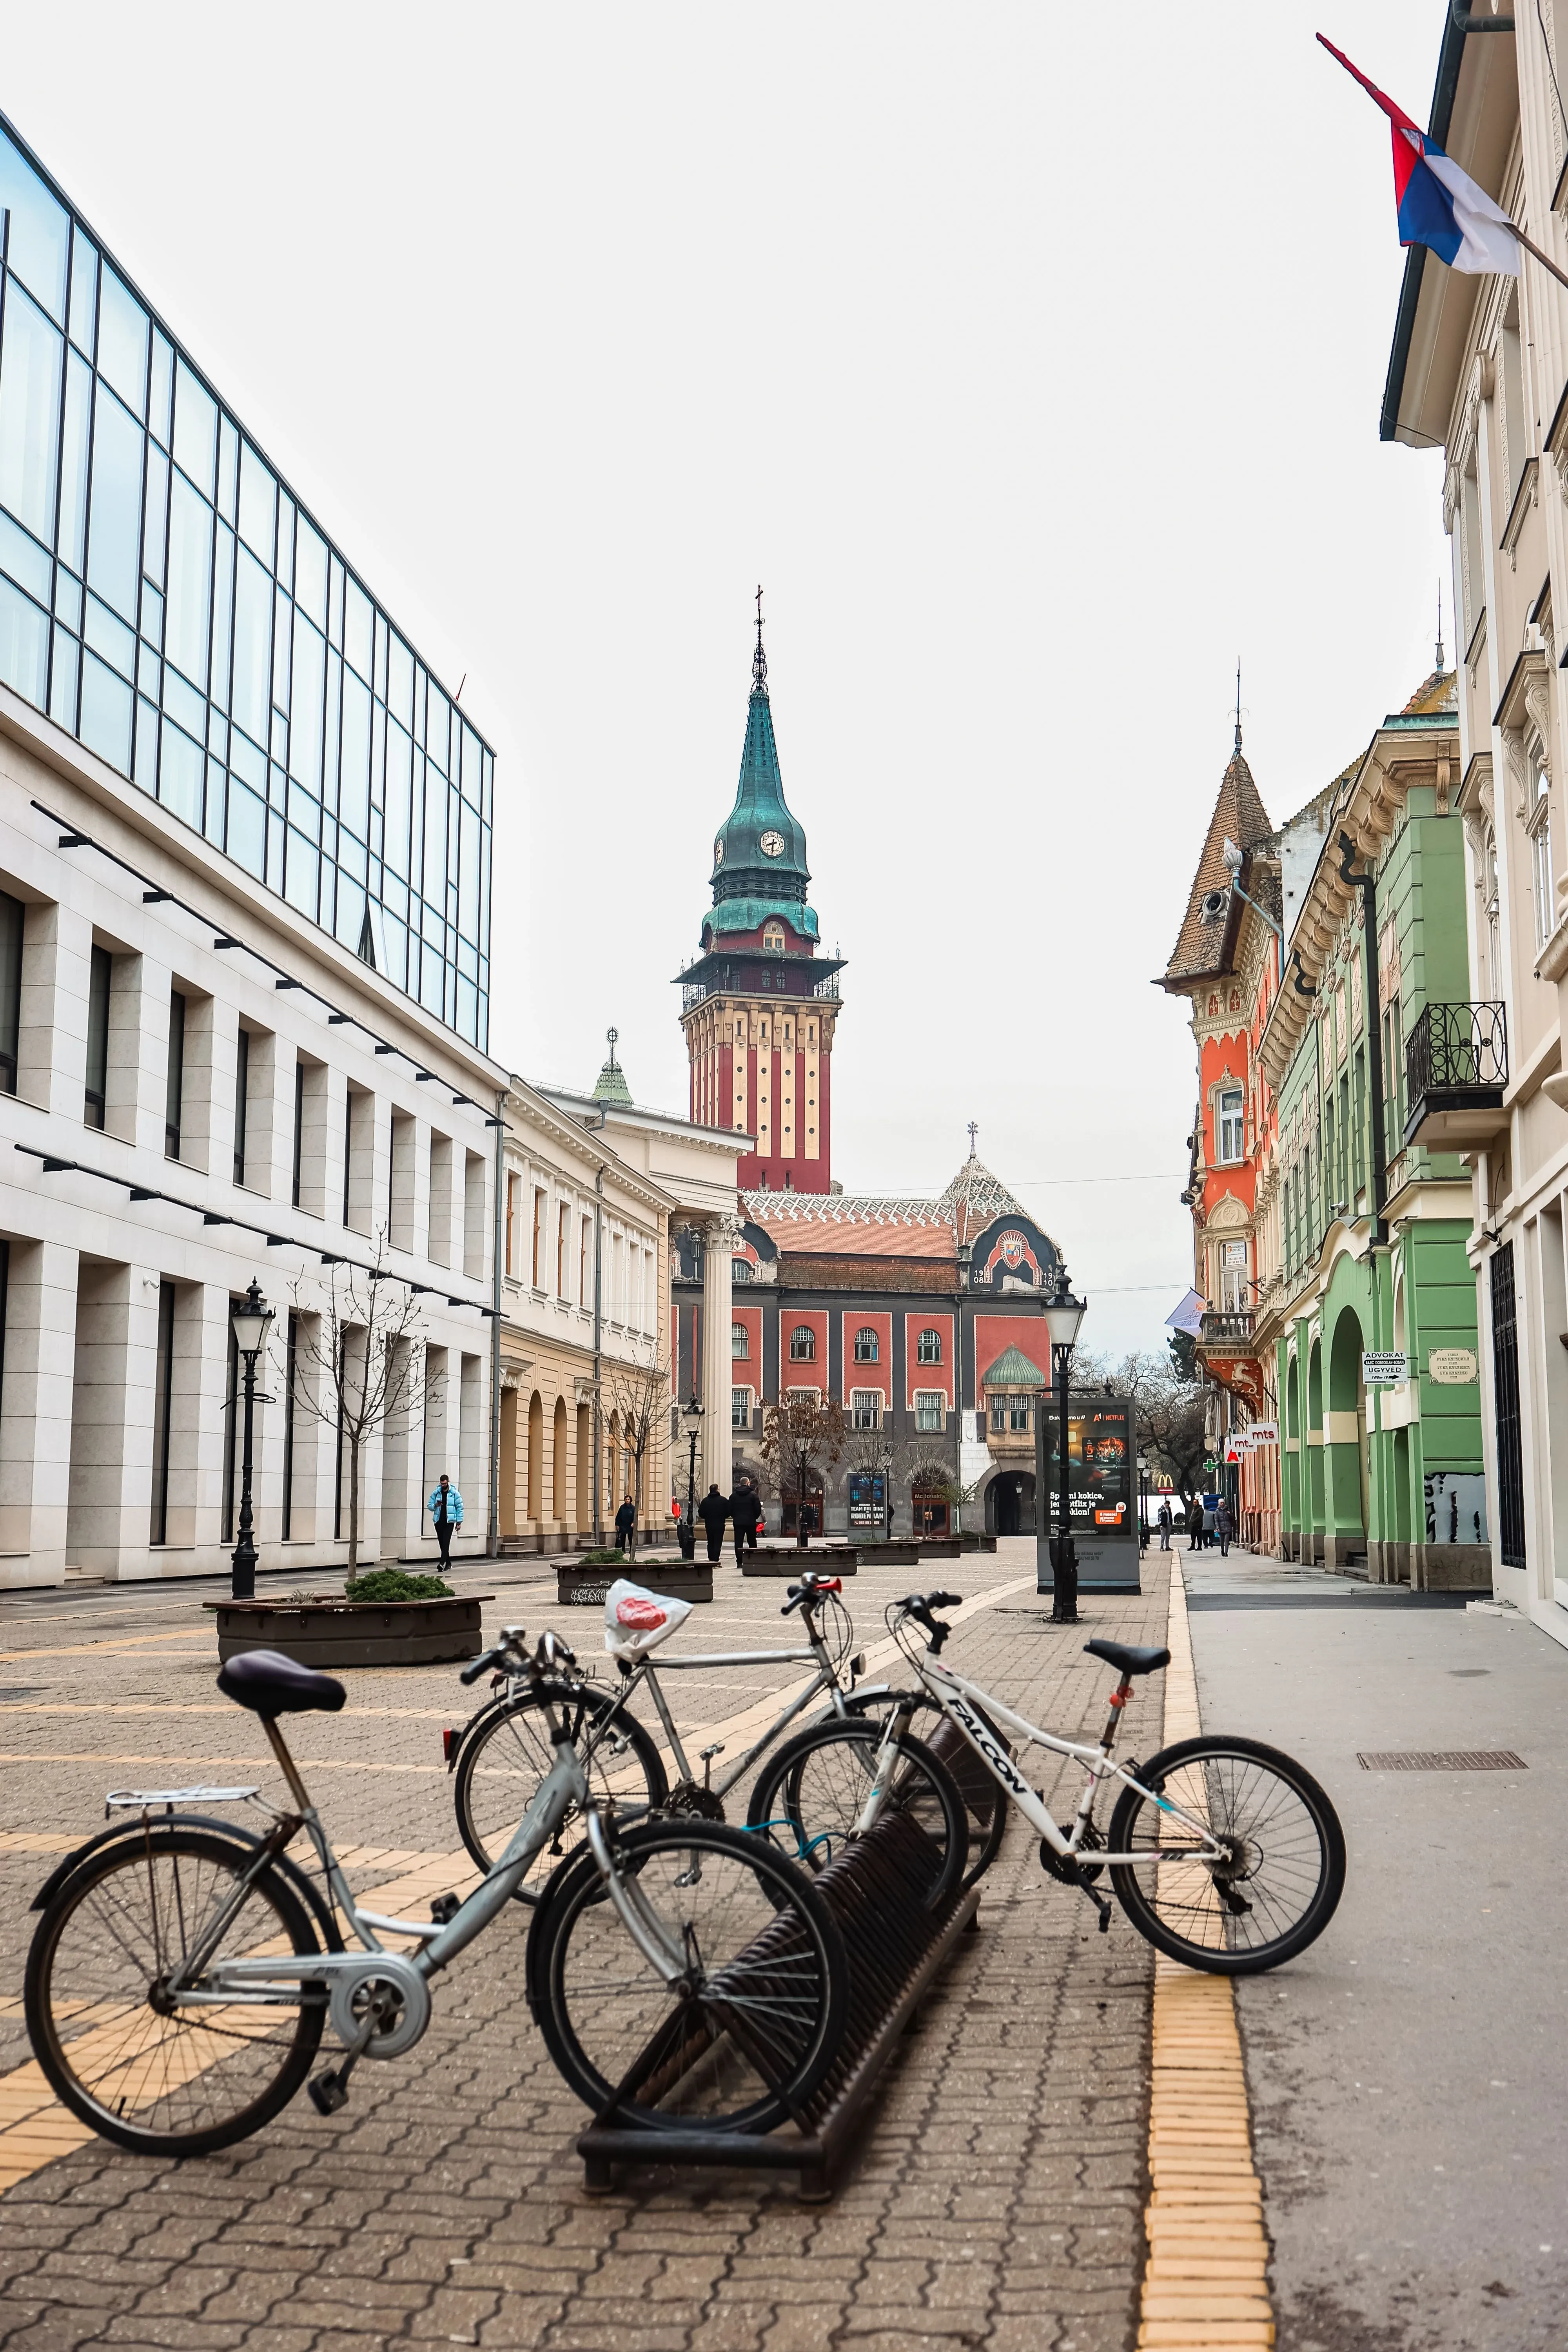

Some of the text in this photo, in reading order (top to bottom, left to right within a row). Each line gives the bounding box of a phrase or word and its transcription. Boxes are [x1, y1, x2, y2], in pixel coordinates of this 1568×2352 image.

[1093, 1413, 1102, 1422] A1
[1252, 1430, 1274, 1440] mts
[1078, 1492, 1104, 1500] kokice,
[1089, 1501, 1096, 1509] je
[947, 1699, 1027, 1793] FALCON
